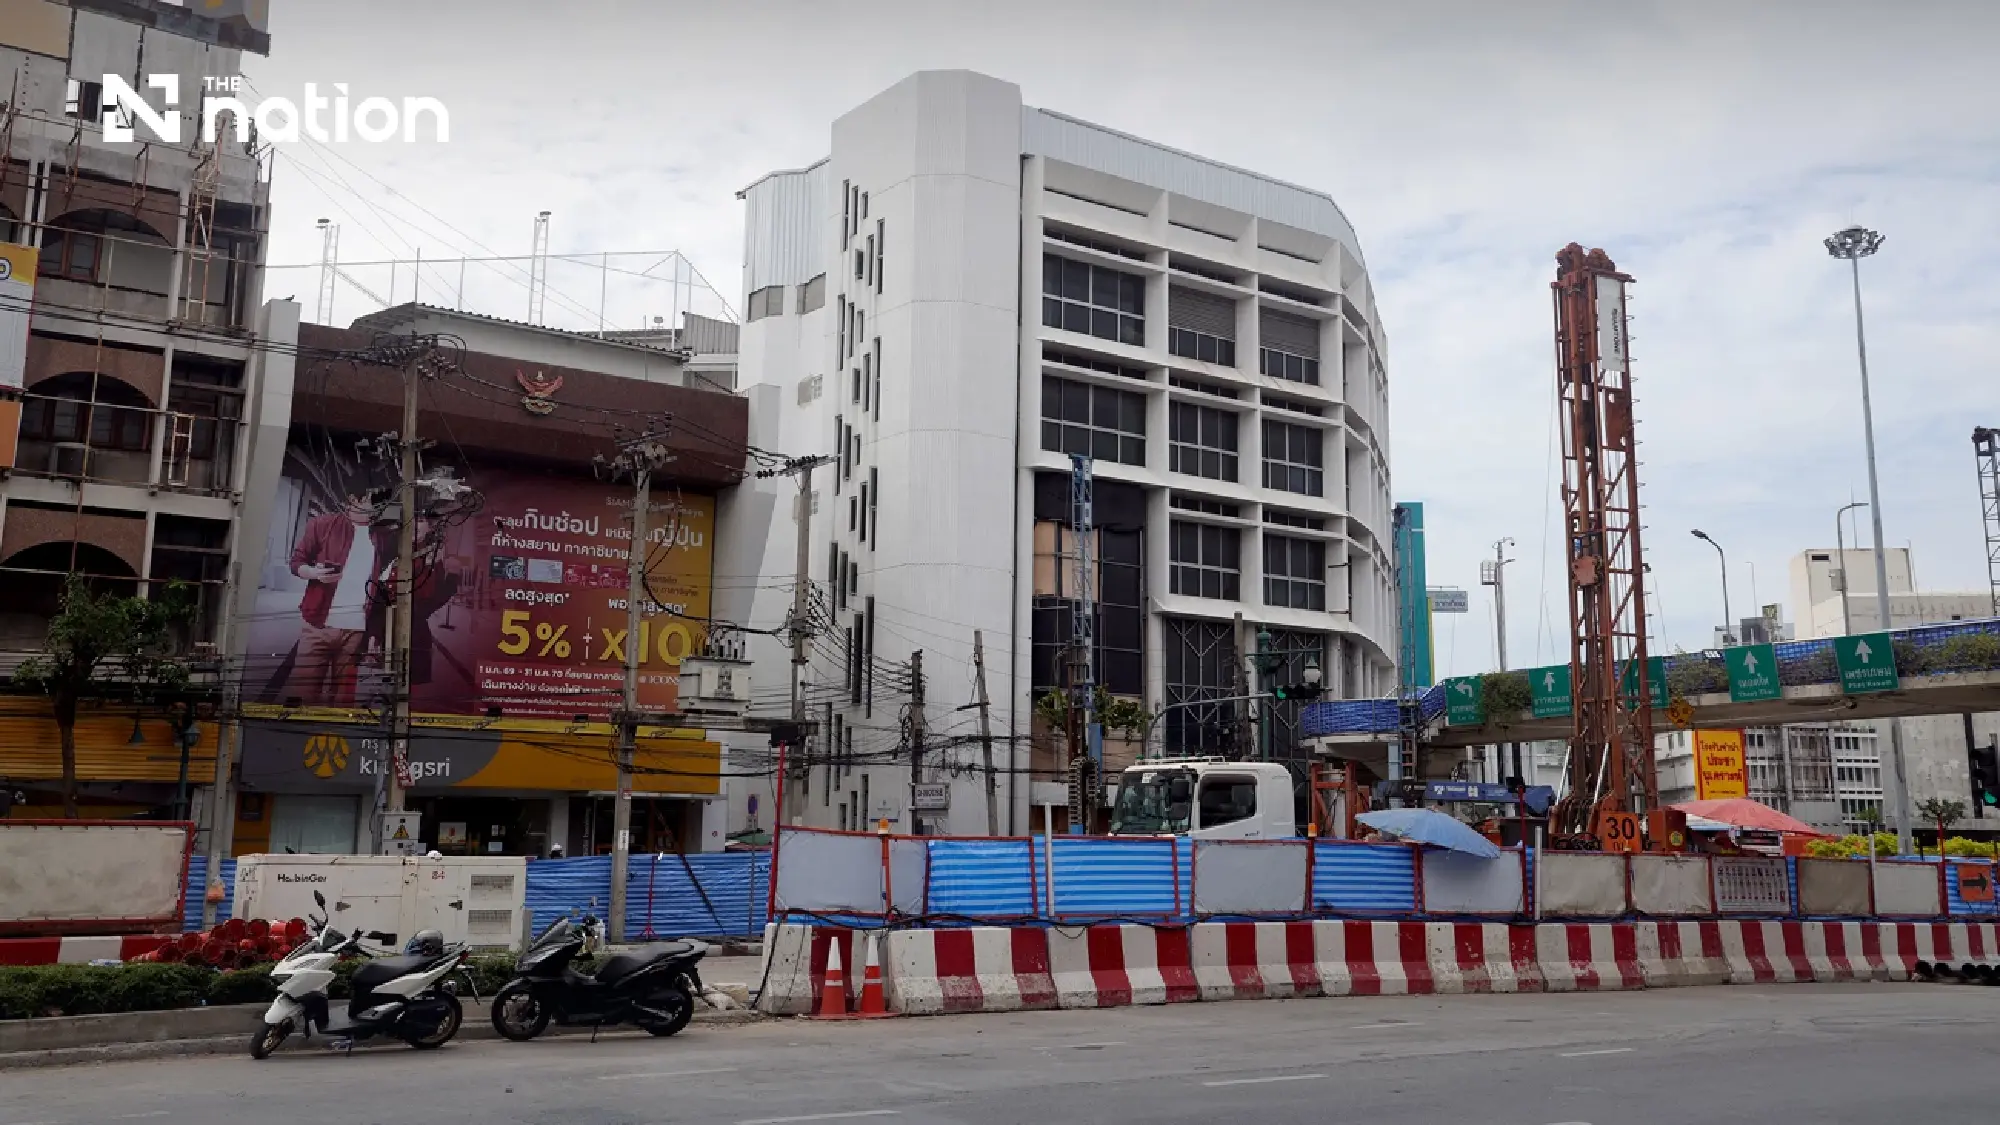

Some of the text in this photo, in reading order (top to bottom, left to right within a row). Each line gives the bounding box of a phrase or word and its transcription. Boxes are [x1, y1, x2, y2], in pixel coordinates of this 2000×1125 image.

[498, 608, 571, 658] 5%
[360, 756, 450, 780] krgsri
[1606, 816, 1634, 839] 30
